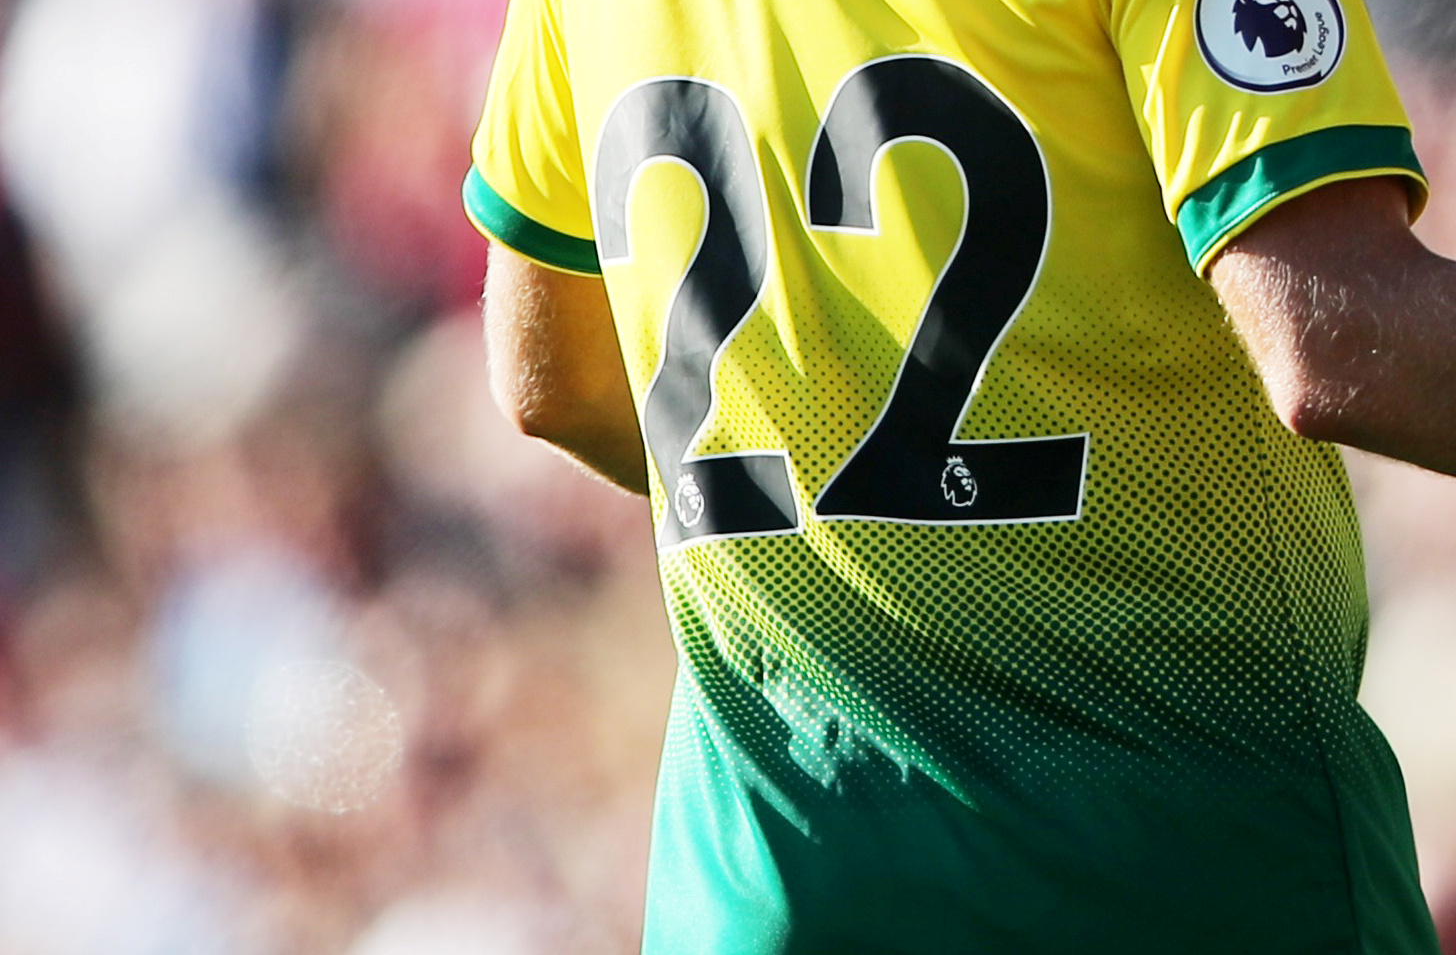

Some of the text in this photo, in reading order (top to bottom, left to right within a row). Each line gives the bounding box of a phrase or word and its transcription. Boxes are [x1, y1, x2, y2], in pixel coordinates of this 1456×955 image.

[1282, 12, 1330, 75] Premier League
[595, 54, 1090, 552] 22
